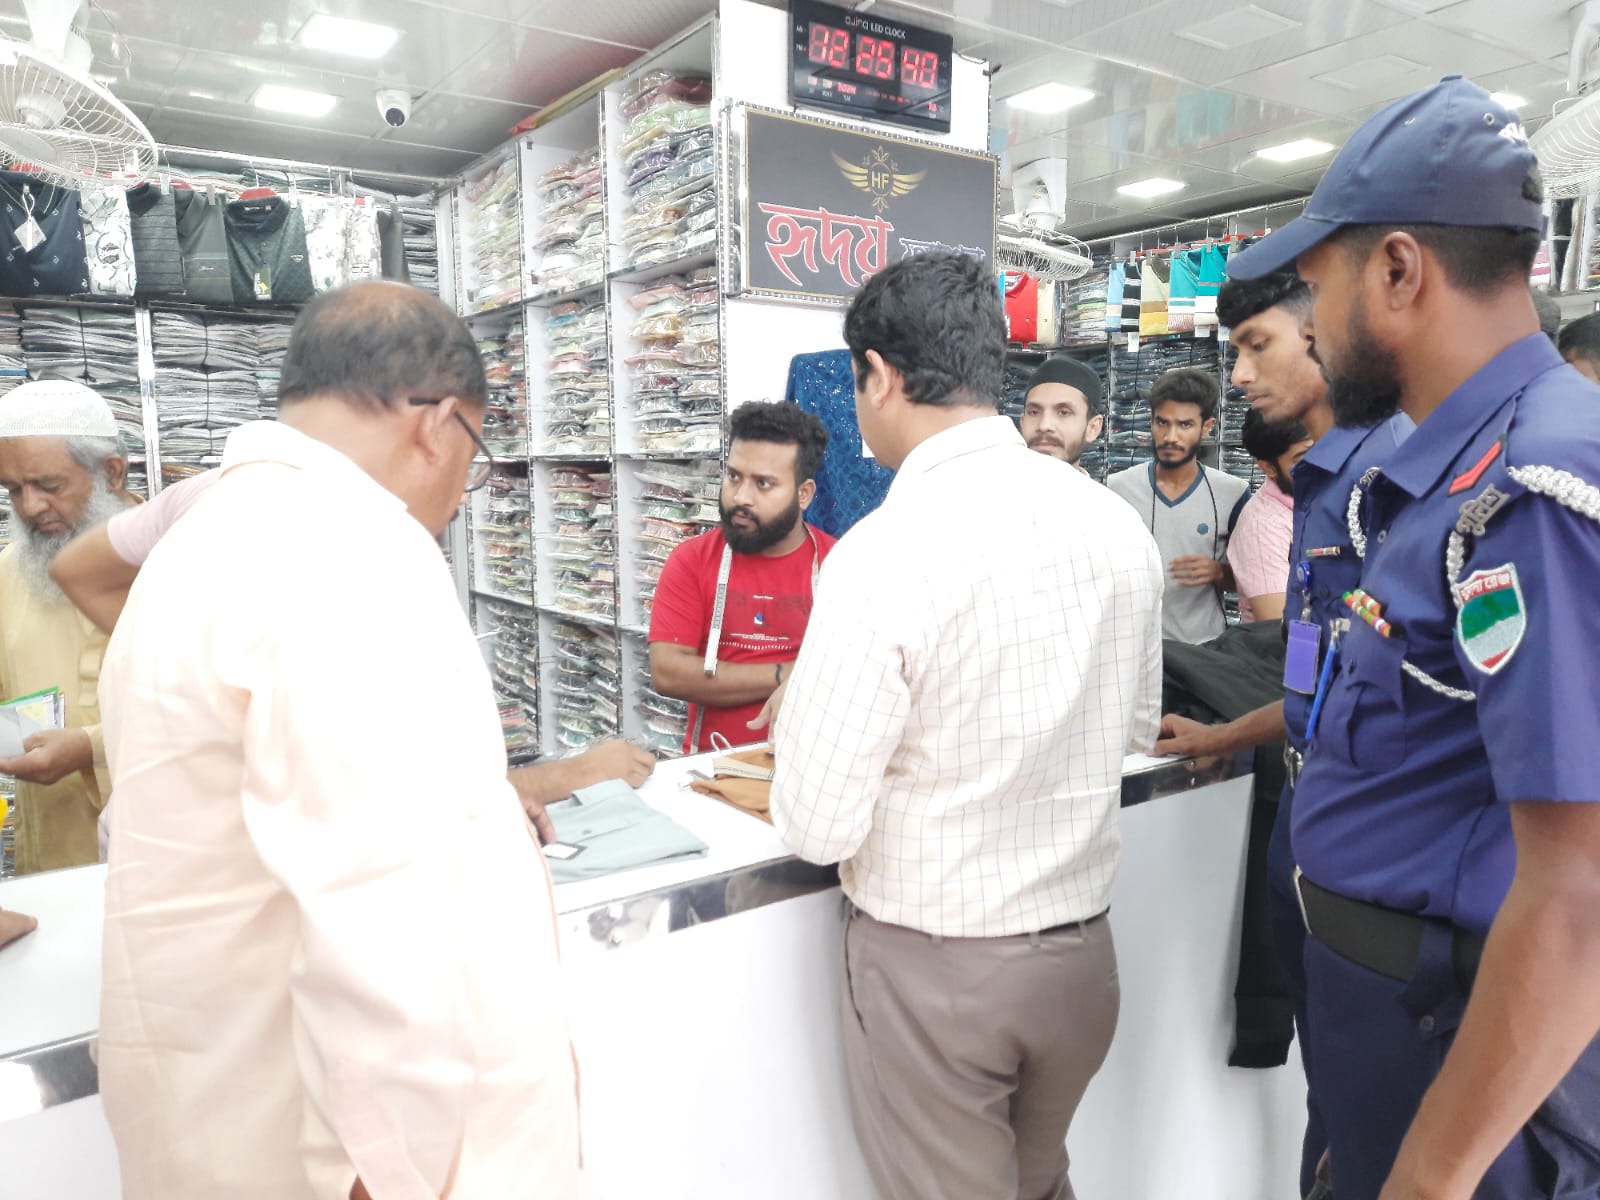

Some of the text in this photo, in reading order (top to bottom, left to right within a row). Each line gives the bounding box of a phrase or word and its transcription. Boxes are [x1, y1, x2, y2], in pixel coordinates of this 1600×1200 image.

[869, 22, 884, 34] LED
[884, 25, 906, 40] CLOCK
[870, 171, 890, 191] HF
[1456, 482, 1511, 536] পুলিশ
